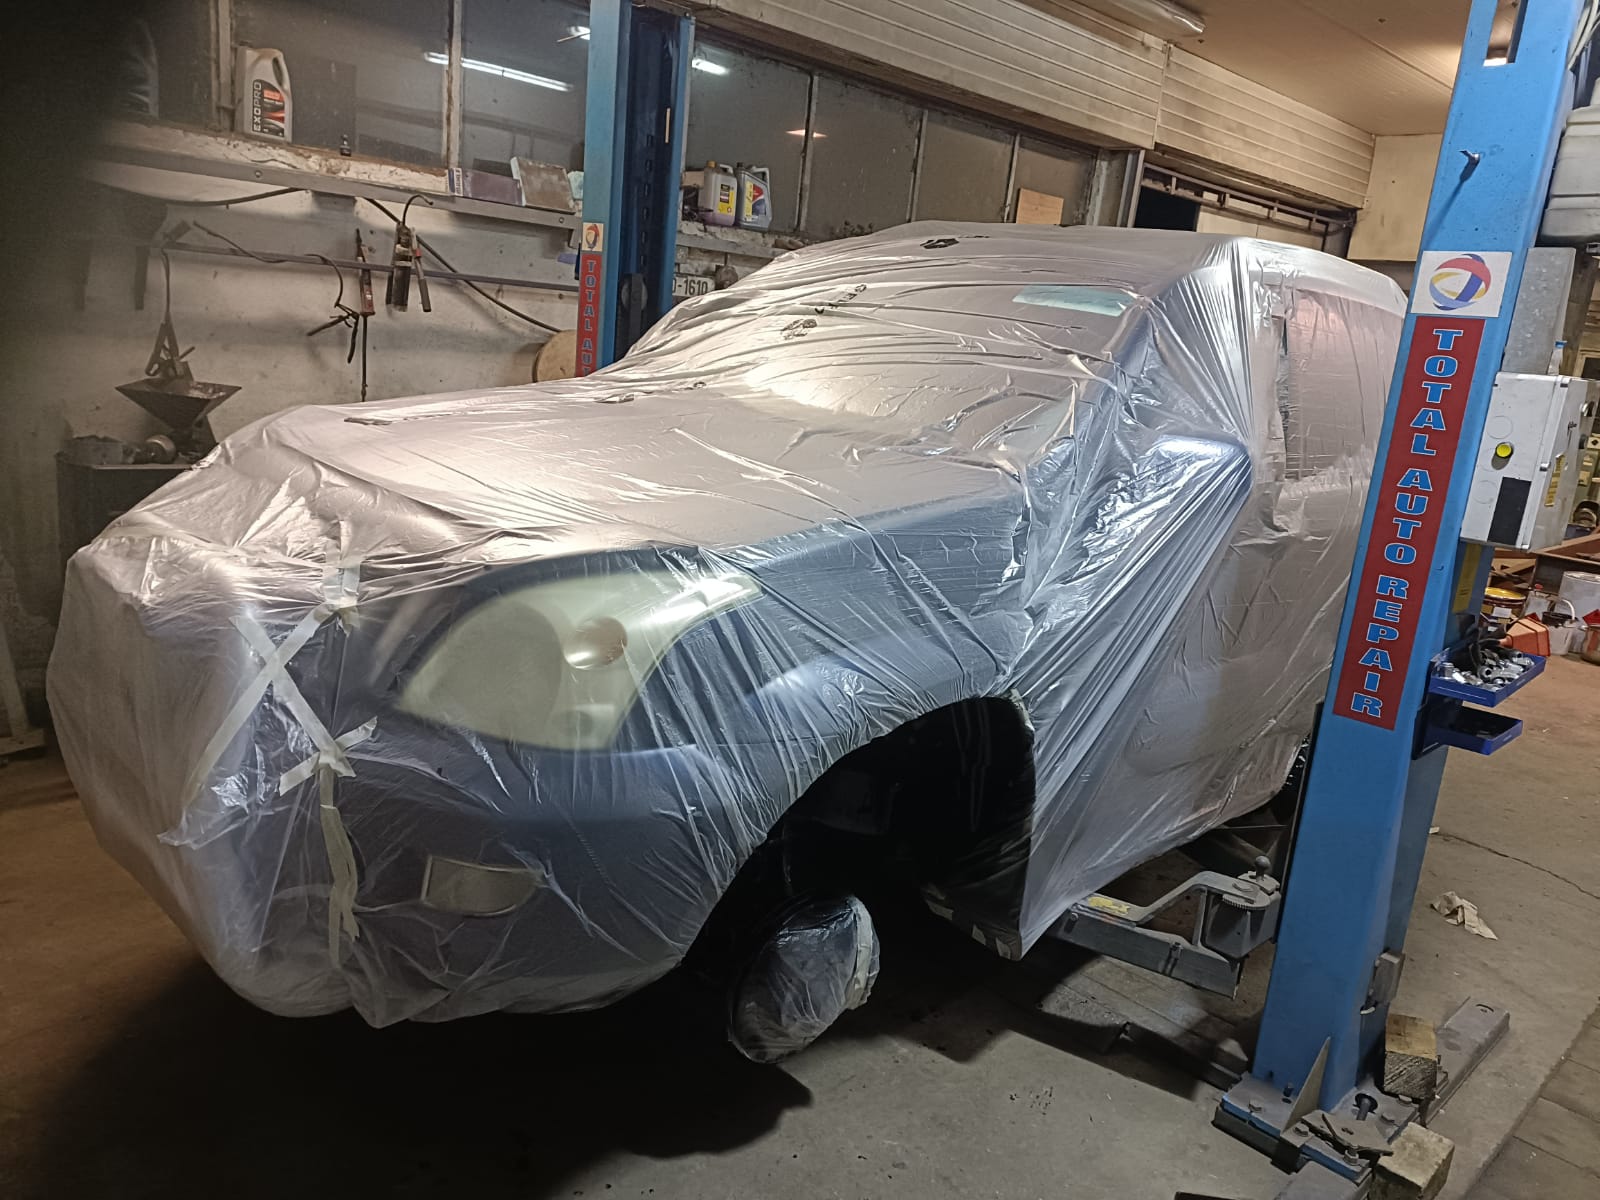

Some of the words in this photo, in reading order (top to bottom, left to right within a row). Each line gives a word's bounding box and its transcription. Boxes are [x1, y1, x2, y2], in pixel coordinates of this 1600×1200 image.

[253, 82, 262, 132] EXOPRO
[584, 260, 597, 331] TOTAL
[581, 338, 593, 376] AUT
[1410, 328, 1464, 456] TOTAL
[1384, 467, 1433, 565] AUTO
[1350, 574, 1409, 718] REPAIR
